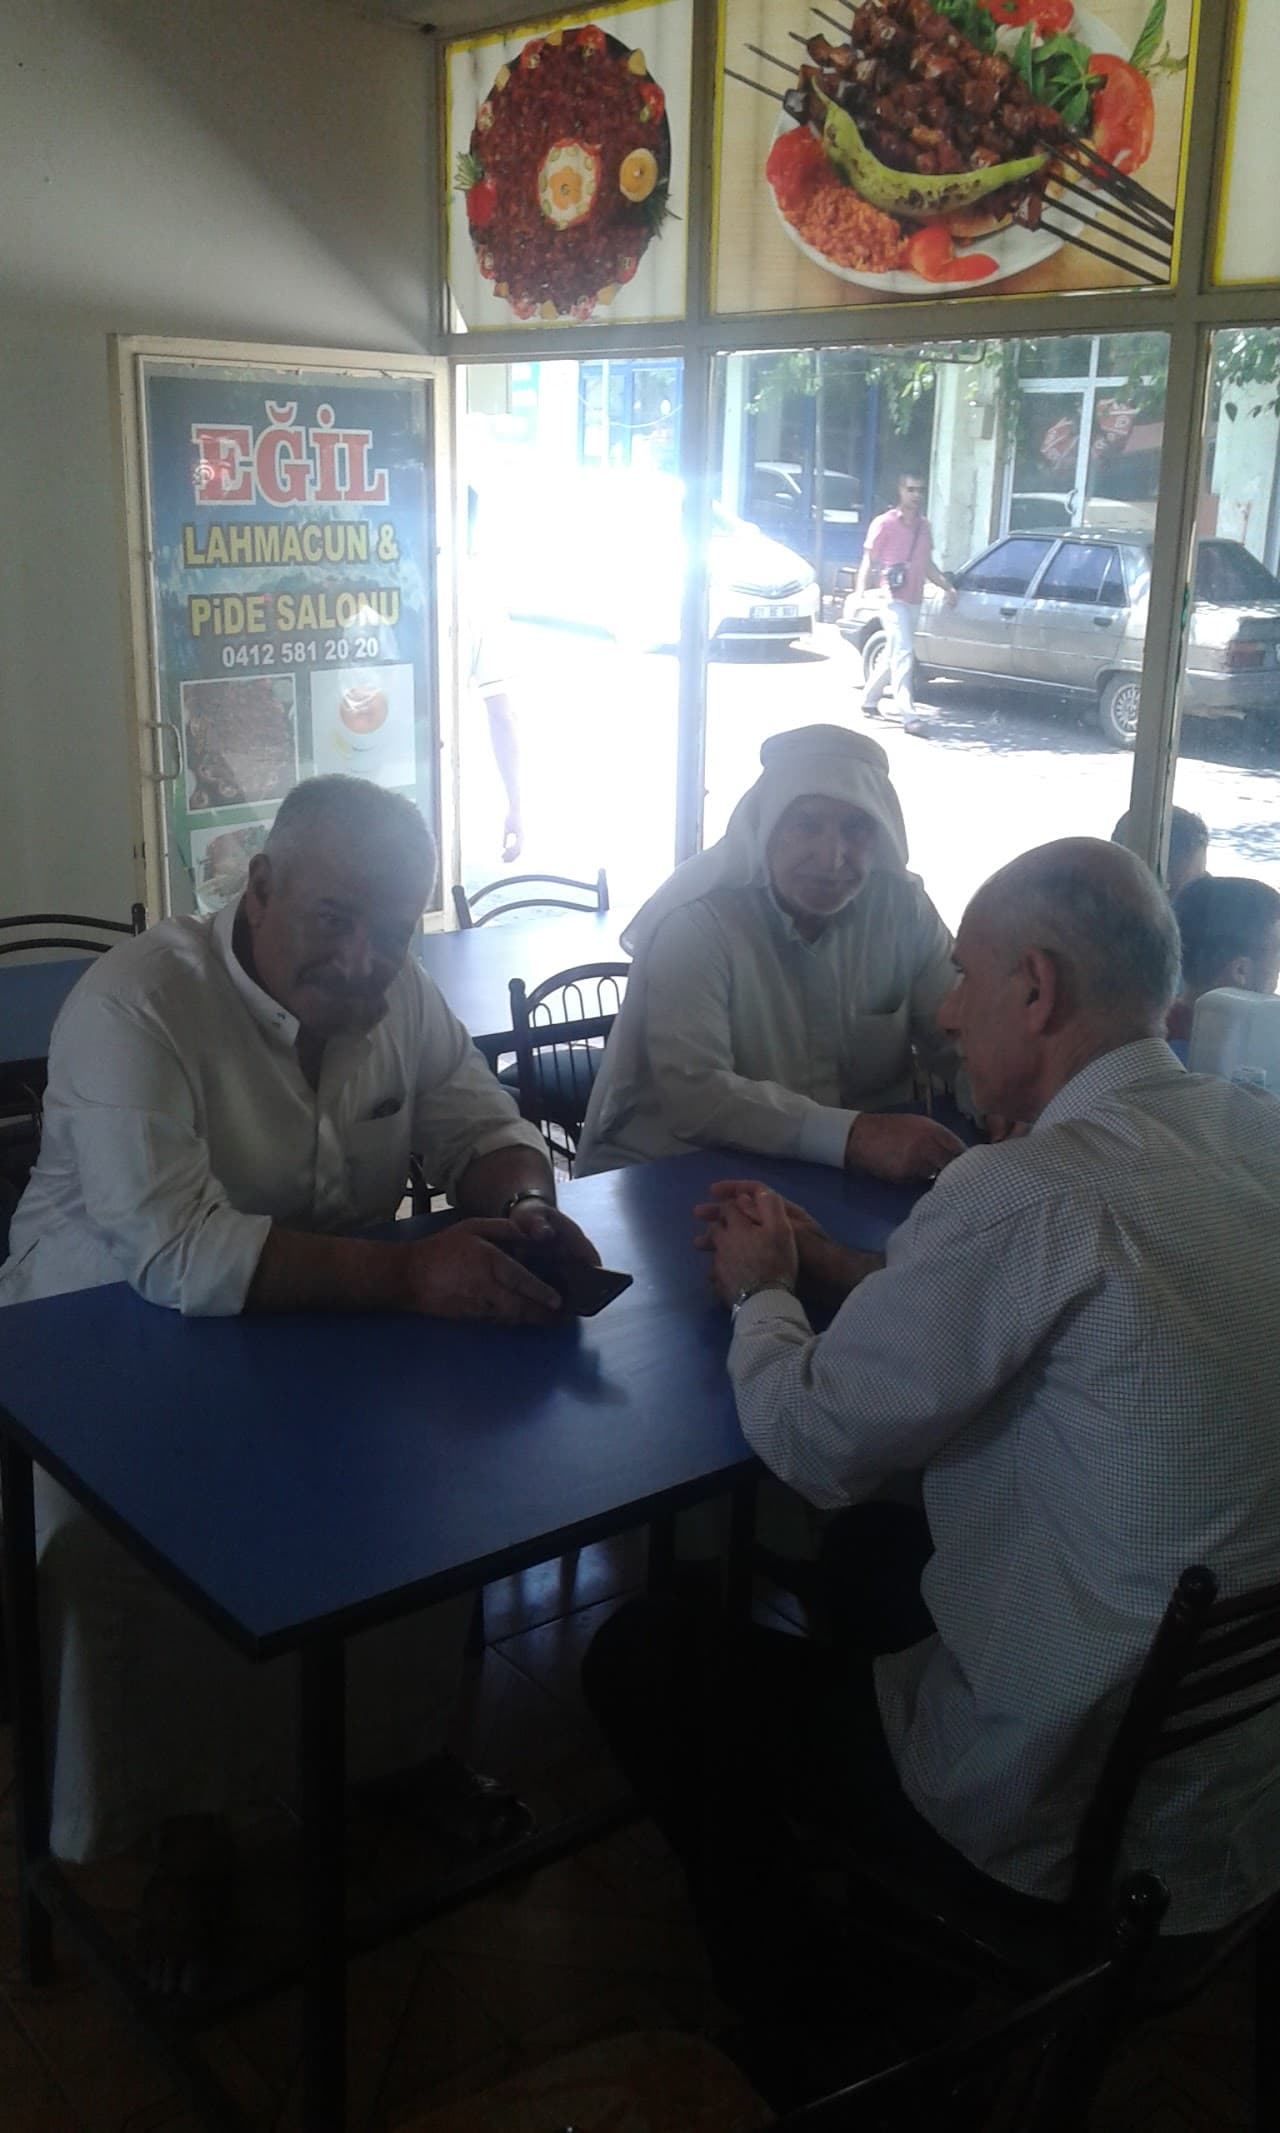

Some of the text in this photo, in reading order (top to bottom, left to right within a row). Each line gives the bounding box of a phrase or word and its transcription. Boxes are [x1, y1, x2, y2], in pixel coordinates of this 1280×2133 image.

[192, 401, 389, 507] EĞİL
[185, 523, 399, 566] LAHMACUN &
[277, 591, 400, 631] SALONU
[222, 637, 379, 668] 0412 581 20 20
